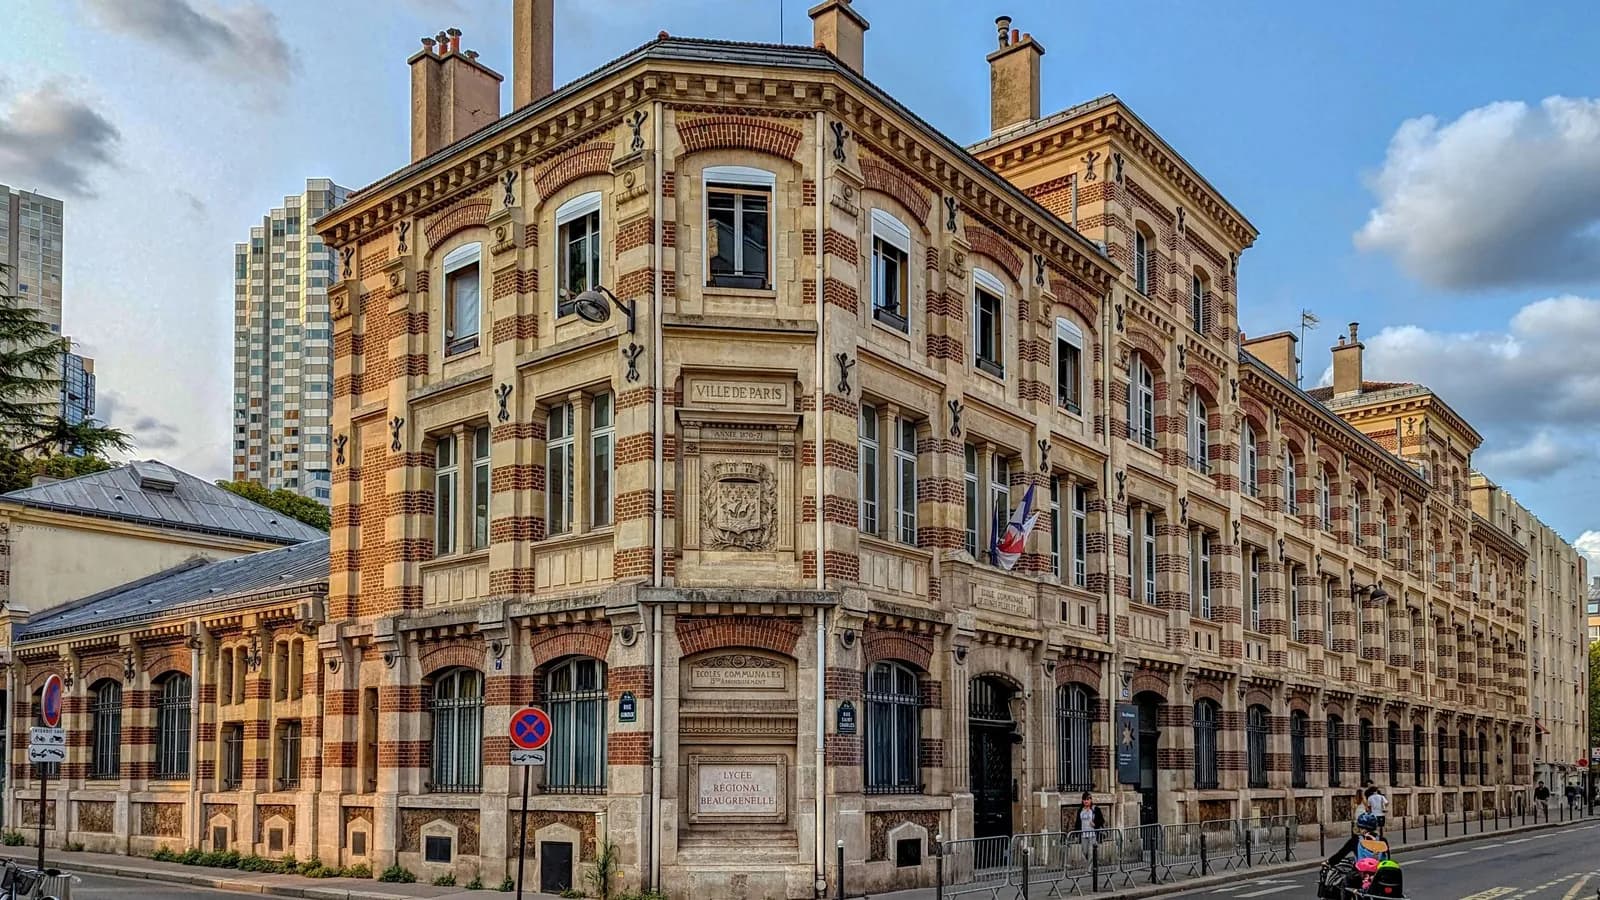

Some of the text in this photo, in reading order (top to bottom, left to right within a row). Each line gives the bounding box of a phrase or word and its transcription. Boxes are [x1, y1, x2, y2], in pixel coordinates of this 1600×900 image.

[696, 385, 782, 400] VILLE DE PARIS
[724, 671, 781, 679] COMMUNALES
[723, 770, 753, 779] LYCÉE
[713, 782, 761, 792] RÉGIONAL
[701, 796, 775, 805] BEAUGRENELLE
